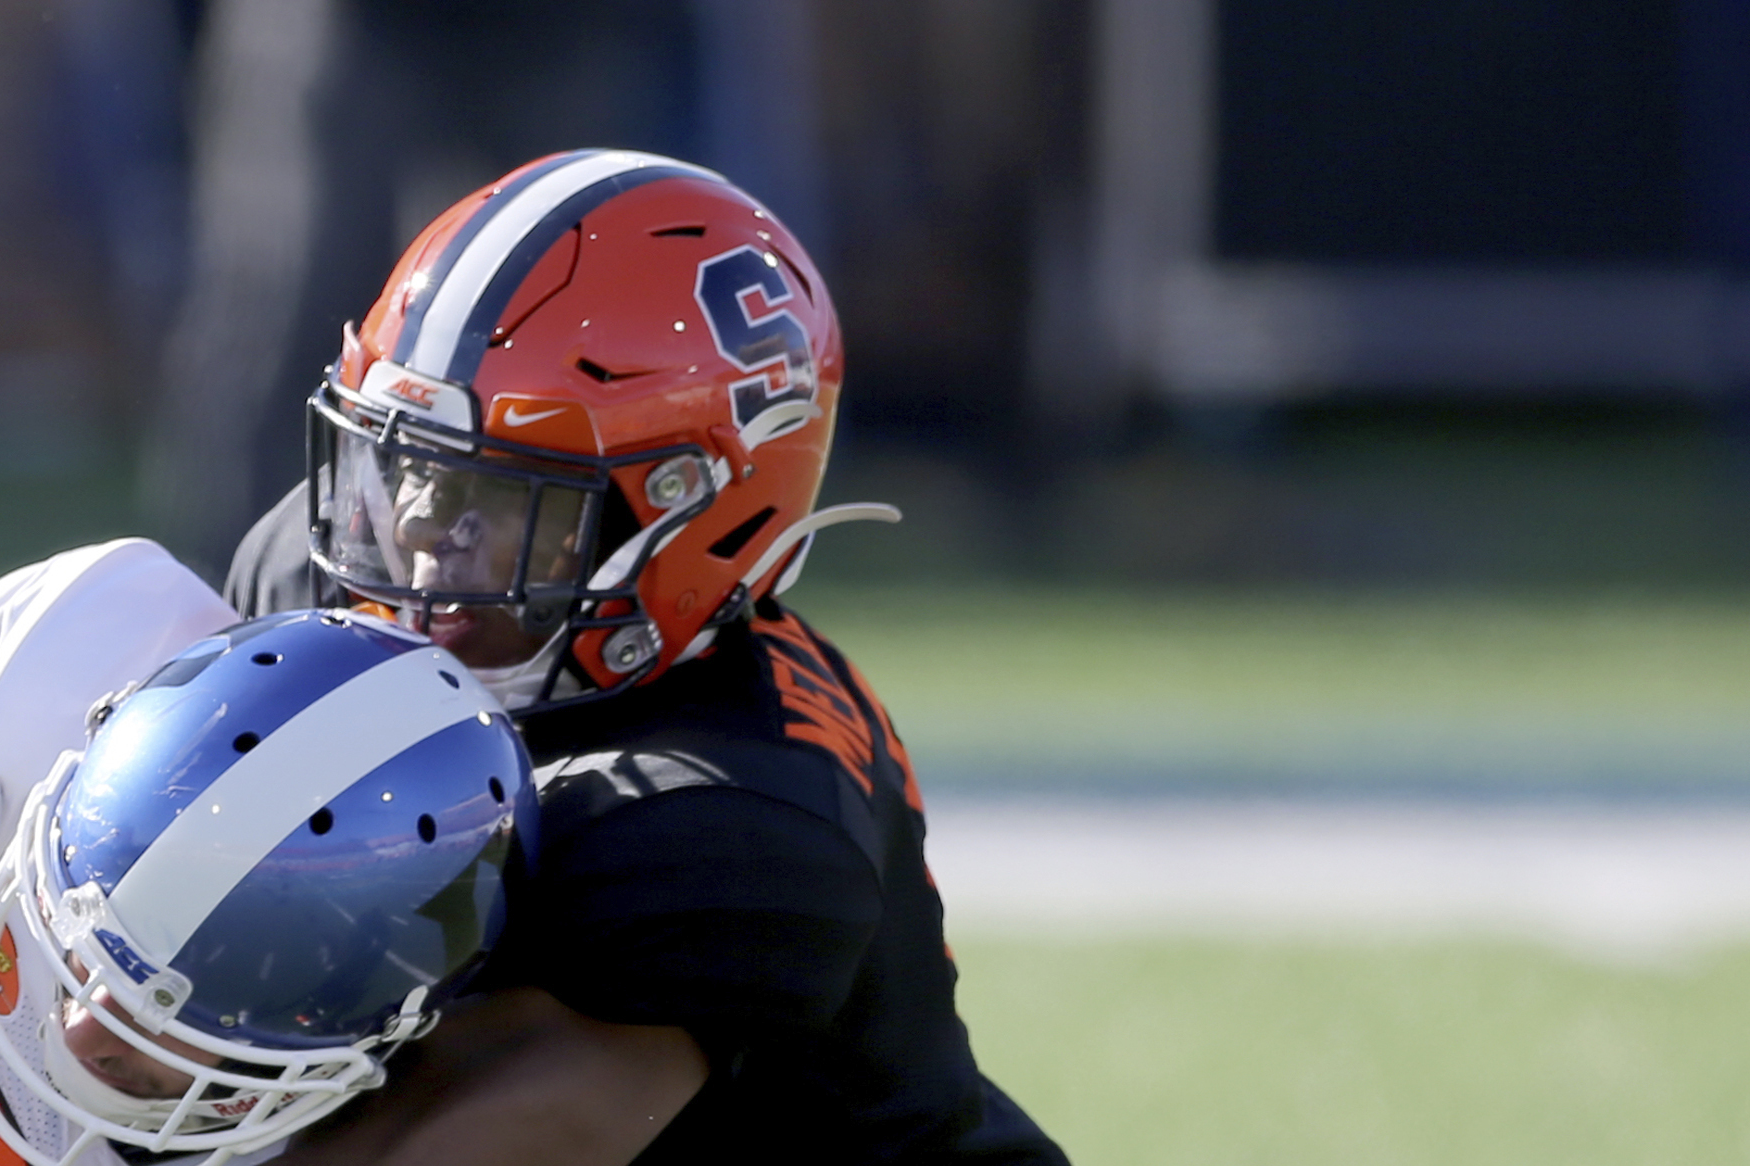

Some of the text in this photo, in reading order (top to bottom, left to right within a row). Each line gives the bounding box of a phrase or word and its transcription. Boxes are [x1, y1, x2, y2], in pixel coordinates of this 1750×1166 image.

[693, 243, 818, 447] S
[383, 377, 440, 411] ACC
[92, 928, 160, 985] ACC
